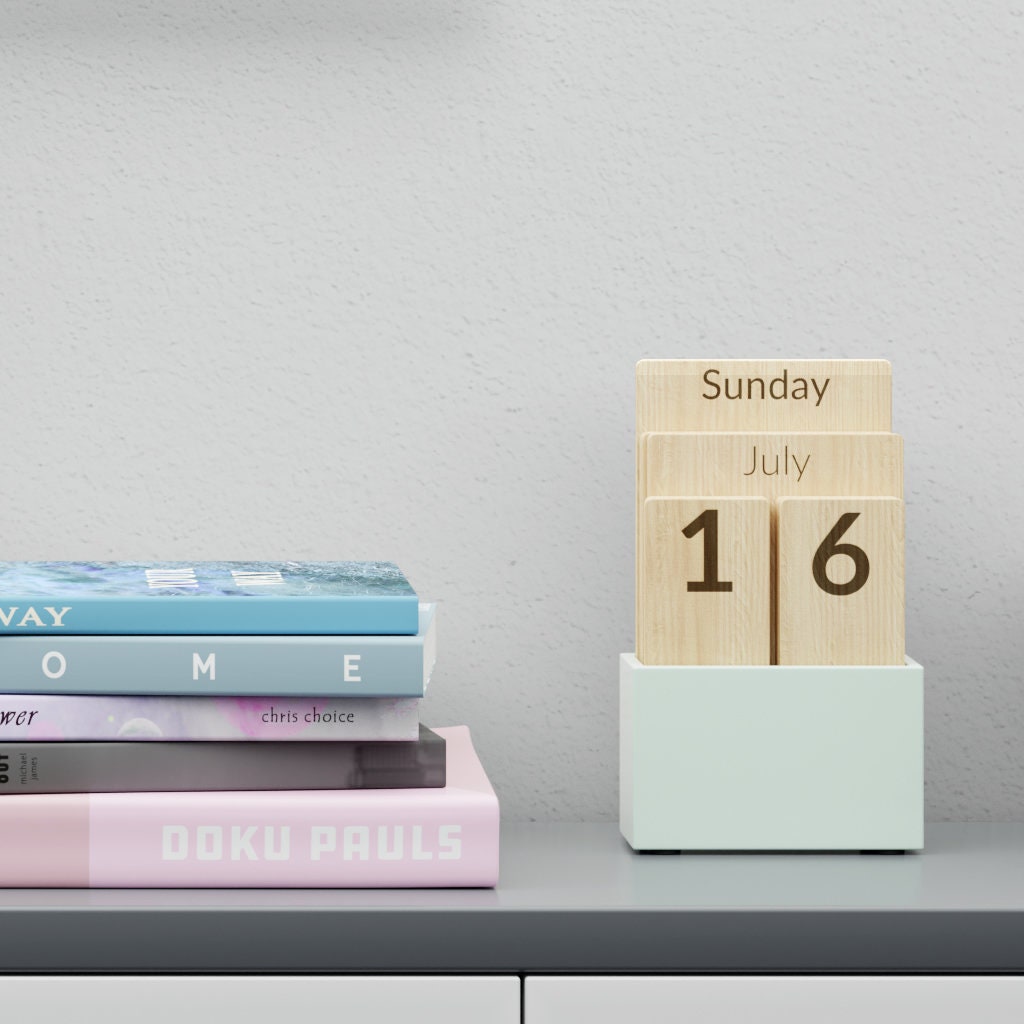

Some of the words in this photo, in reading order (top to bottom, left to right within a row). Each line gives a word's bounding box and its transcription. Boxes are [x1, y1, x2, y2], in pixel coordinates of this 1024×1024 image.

[701, 369, 831, 407] Sunday
[743, 445, 811, 482] July
[261, 706, 299, 724] chris
[303, 706, 355, 724] choice
[19, 752, 28, 785] michael
[161, 824, 291, 861] DOKU
[310, 824, 463, 861] PAULS
